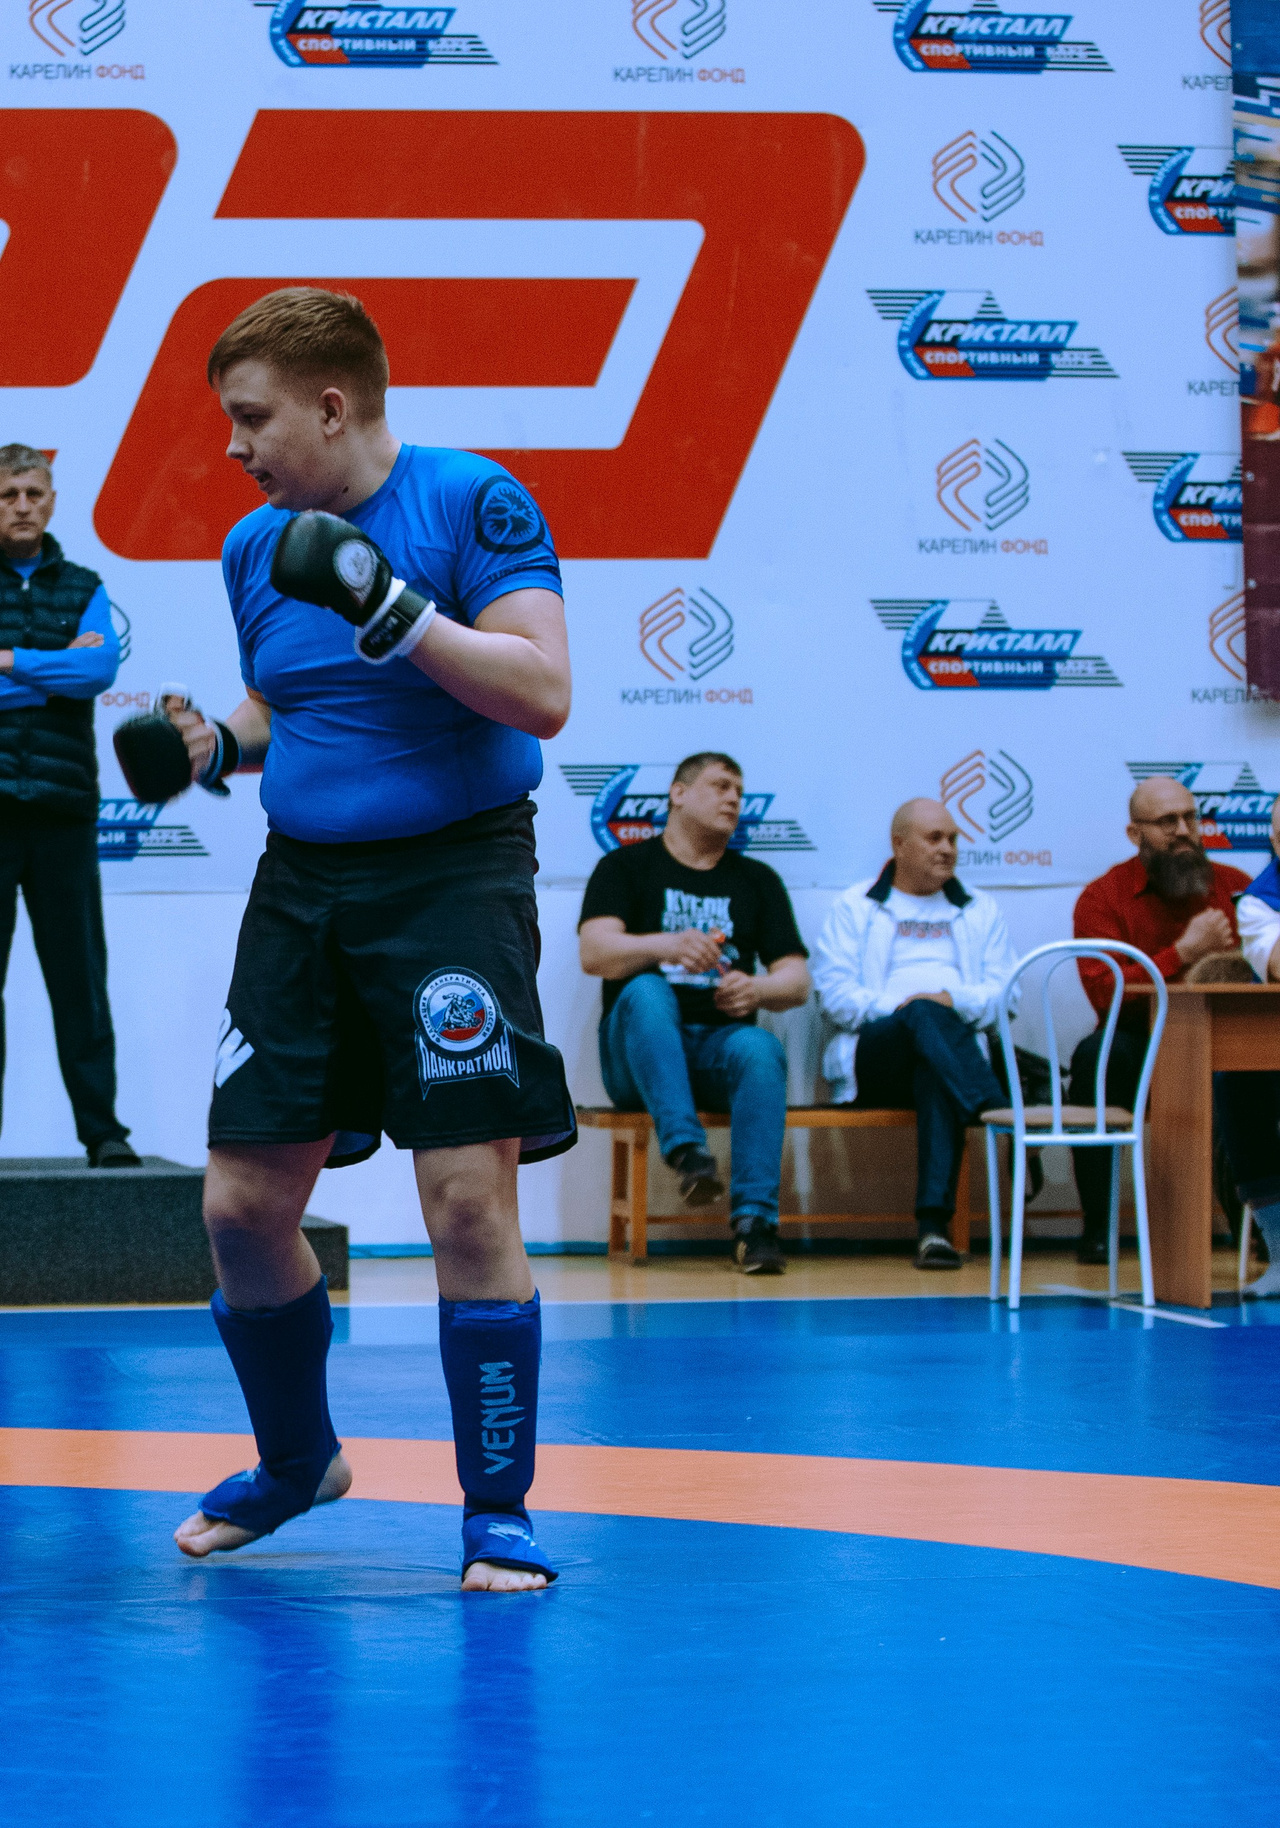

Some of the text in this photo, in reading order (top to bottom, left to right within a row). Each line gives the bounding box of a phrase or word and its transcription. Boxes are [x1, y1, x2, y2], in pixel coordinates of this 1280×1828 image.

[296, 10, 448, 30] КРИСТАЛЛ
[919, 16, 1066, 36] КРИСТАЛЛ
[297, 38, 417, 51] СПОРТИВНЫЙ
[921, 43, 1035, 57] СПОРТИВНЫЙ
[10, 63, 145, 80] КАРЕЛИН ФОНД
[614, 66, 745, 84] КАРЕЛИН ФОНД
[914, 229, 1044, 247] КАРЕЛИН ФОНД
[924, 322, 1070, 343] КРИСТАЛЛ
[924, 351, 1040, 365] СПОРТИВНЫЙ
[919, 538, 1049, 555] КАРЕЛИН ФОНД
[928, 632, 1074, 652] КРИСТАЛЛ
[928, 660, 1044, 674] СПОРТИВНЫЙ
[101, 691, 150, 708] ФОНД
[622, 688, 753, 705] КАРЕЛИН ФОНД
[1004, 850, 1052, 867] ФОНД
[420, 1031, 513, 1082] ПАНКРАТИОН
[478, 1360, 526, 1475] VENUM
